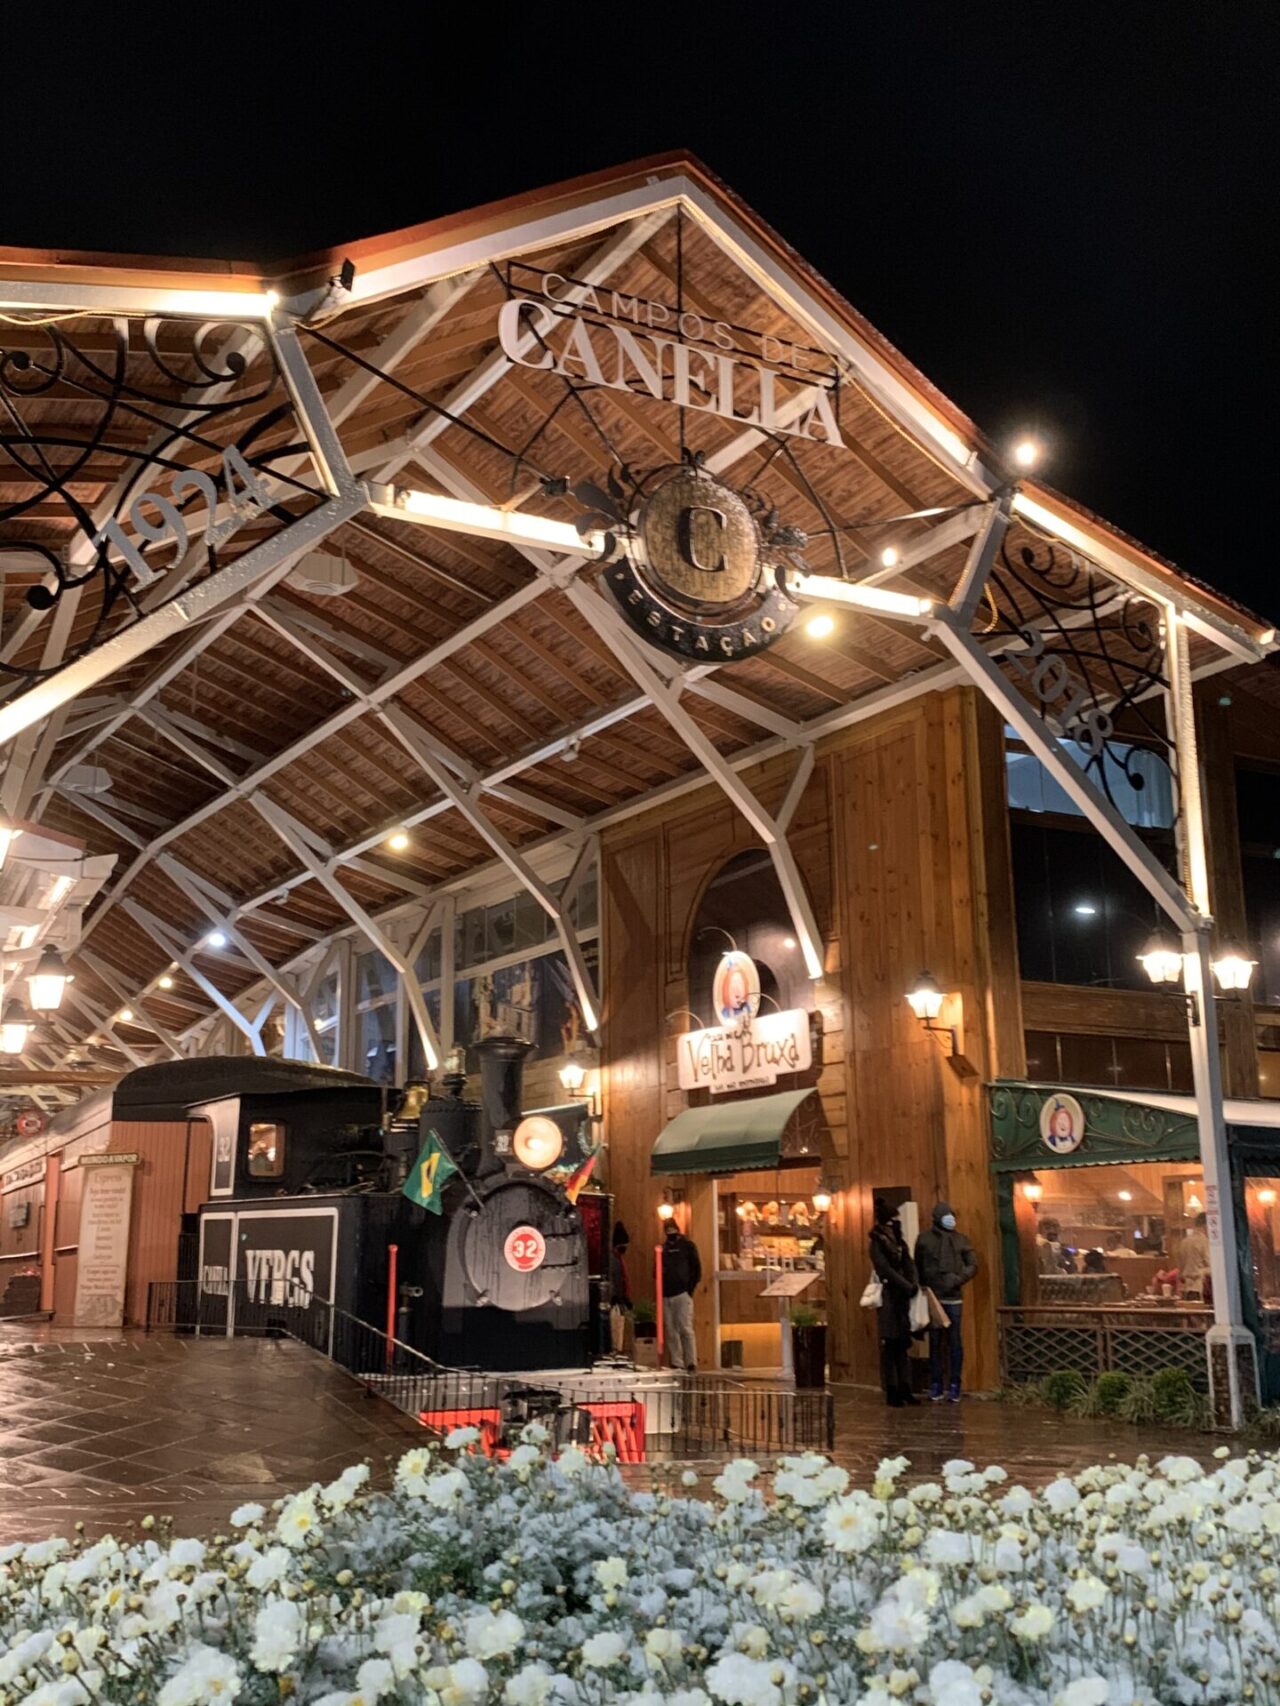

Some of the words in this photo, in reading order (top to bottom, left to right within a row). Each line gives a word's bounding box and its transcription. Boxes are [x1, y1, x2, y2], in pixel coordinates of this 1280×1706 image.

[541, 273, 734, 350] CAMPOS
[761, 334, 811, 371] DE
[498, 299, 847, 448] CANELLA
[92, 444, 281, 594] 1924
[678, 505, 729, 573] C
[628, 588, 777, 657] ESTAÇÃO
[1002, 624, 1114, 756] 2018
[512, 1239, 538, 1259] 32
